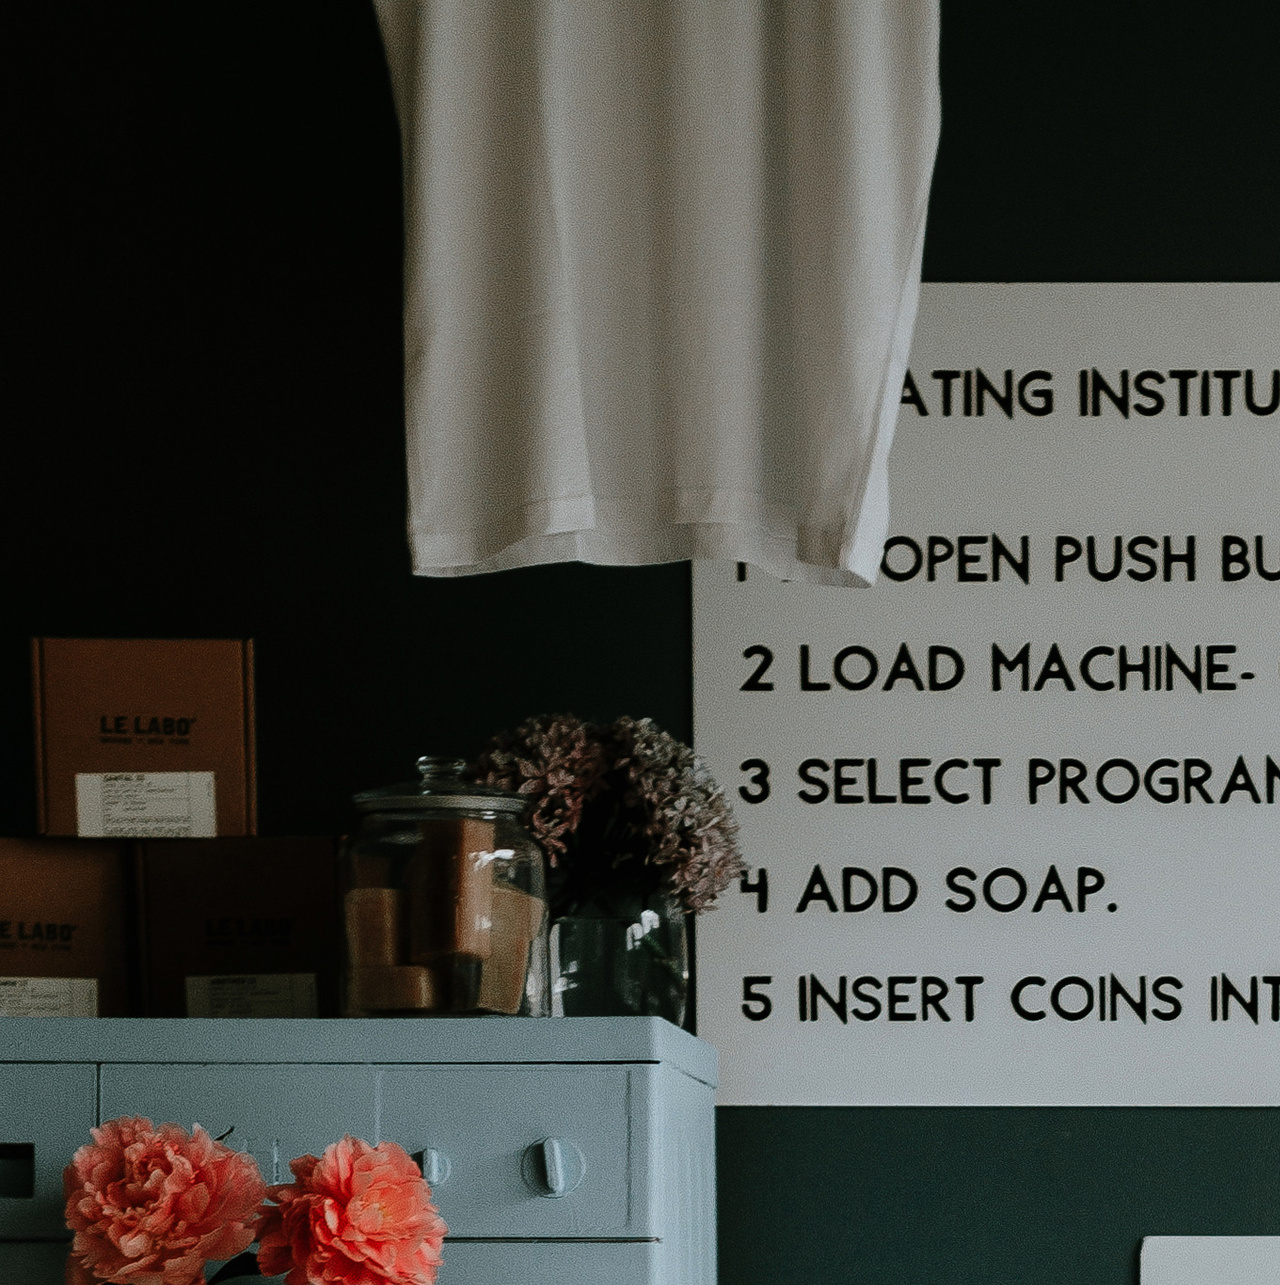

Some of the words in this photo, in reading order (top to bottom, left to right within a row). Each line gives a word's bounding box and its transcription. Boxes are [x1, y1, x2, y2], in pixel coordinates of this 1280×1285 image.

[880, 534, 1031, 586] OPEN
[1055, 535, 1197, 584] PUSH
[740, 645, 776, 693] 2
[799, 642, 967, 693] LOAD
[991, 643, 1256, 695] MACHINE-
[100, 715, 128, 734] LE
[134, 716, 190, 736] LABO
[738, 758, 772, 806] 3
[797, 758, 1003, 806] SELECT
[740, 867, 769, 914] 4
[796, 864, 920, 915] ADD
[946, 864, 1119, 915] SOAP.
[741, 976, 774, 1023] 5
[798, 974, 985, 1027] INSERT
[1011, 974, 1185, 1027] COINS
